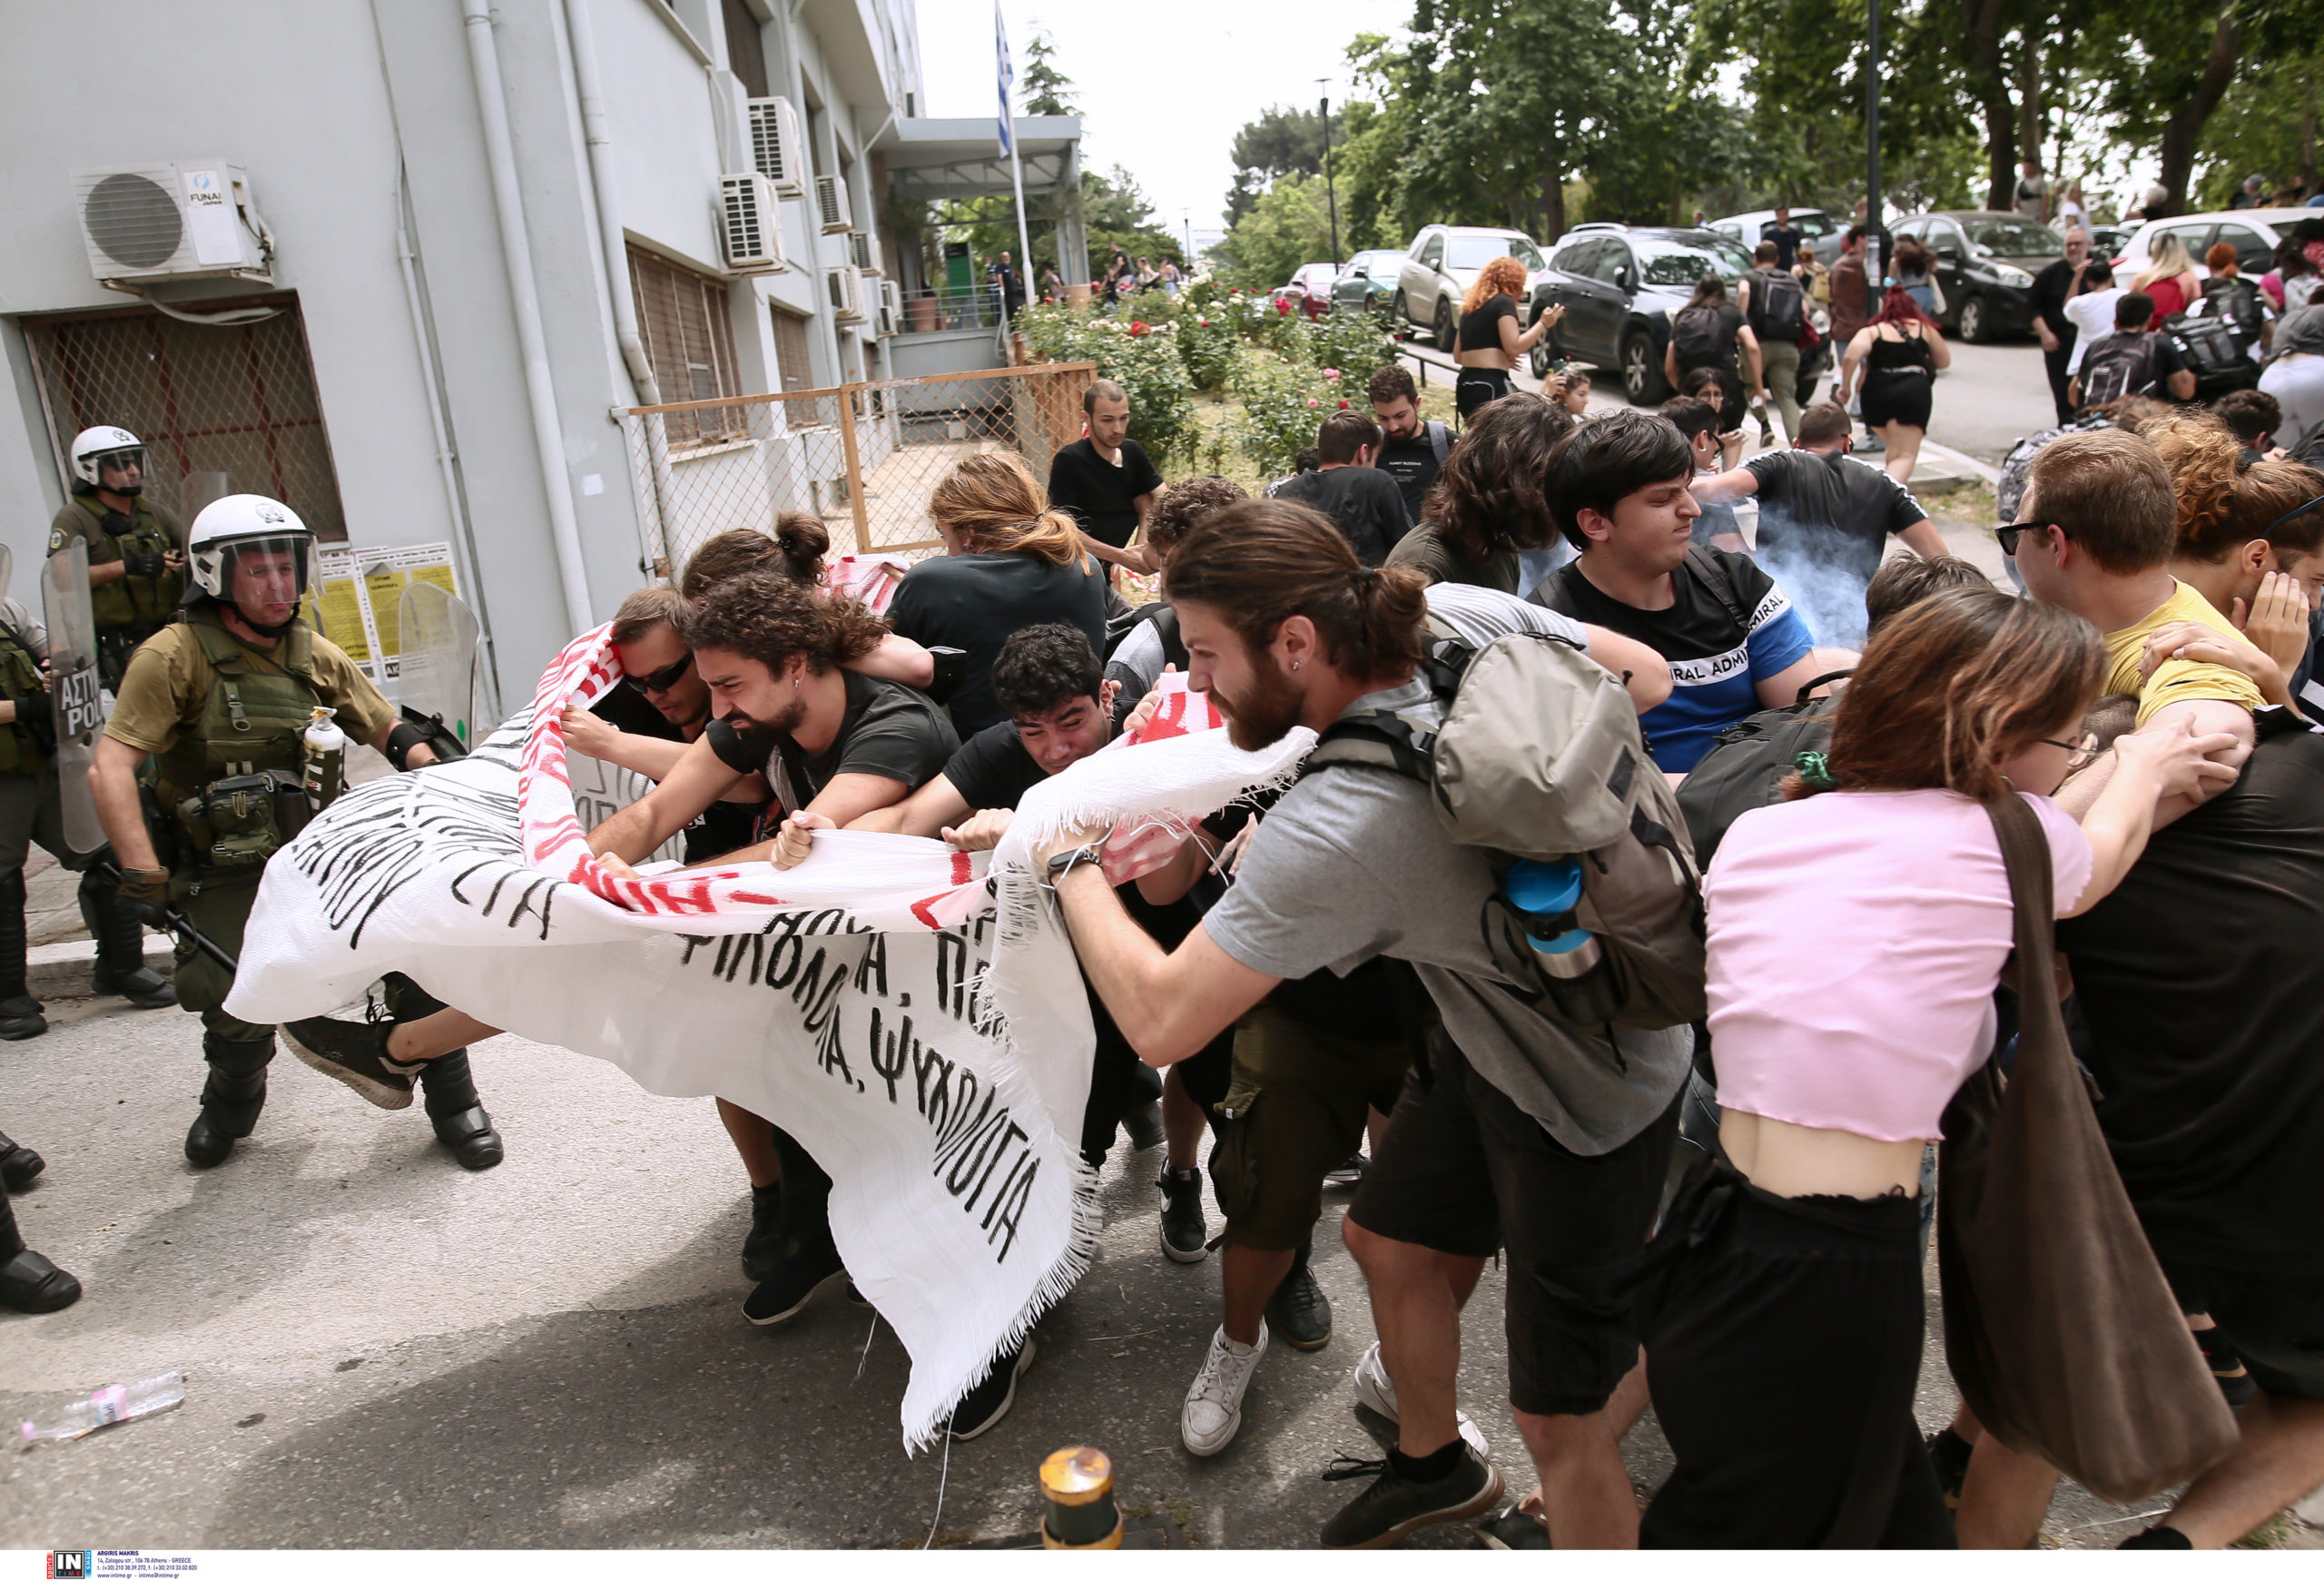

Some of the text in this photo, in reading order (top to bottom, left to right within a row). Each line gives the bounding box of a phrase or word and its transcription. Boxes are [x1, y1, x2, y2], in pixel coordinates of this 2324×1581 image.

[189, 193, 222, 202] FUNAI
[1748, 595, 1784, 632] MIRAL
[1669, 649, 1748, 681] IRAL ADMI
[67, 701, 102, 736] POL
[870, 1007, 1041, 1265] ΨΥΧΟΛΟΓΙΑ
